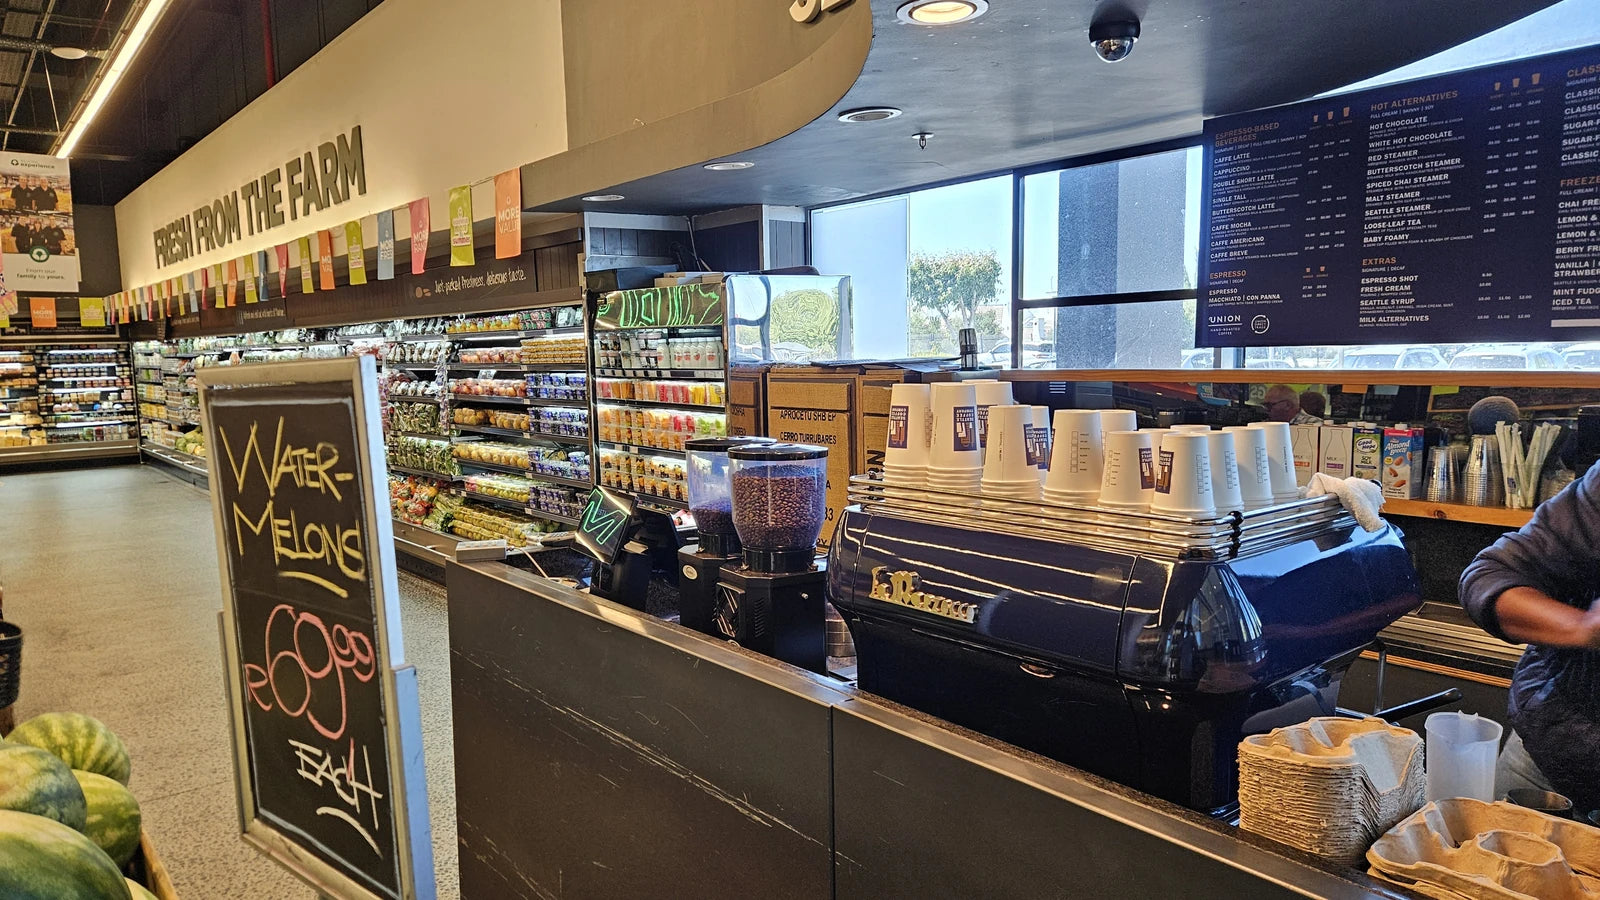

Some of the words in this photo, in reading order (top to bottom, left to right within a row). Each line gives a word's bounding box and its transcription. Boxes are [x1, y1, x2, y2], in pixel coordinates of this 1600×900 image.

[1370, 101, 1388, 112] HOT
[1391, 90, 1458, 108] ALTERNATIVES
[1369, 123, 1383, 131] HOT
[1385, 116, 1428, 128] CHOCOLATE
[1215, 133, 1257, 147] BEVERAGES
[1369, 140, 1391, 148] WHITE
[1393, 137, 1407, 145] HOT
[1410, 130, 1453, 142] CHOCOLATE
[1214, 155, 1232, 164] CAFFE
[1233, 152, 1250, 161] LATTE
[1367, 154, 1382, 162] RED
[1384, 149, 1418, 159] STEAMER
[1561, 150, 1599, 161] CLASSIC
[1214, 165, 1250, 176] CAPPUCCINO
[1367, 163, 1423, 176] BUTTERSCOTCH
[1425, 157, 1461, 167] STEAMER
[1213, 179, 1235, 188] DOUBLE
[1236, 176, 1256, 185] SHORT
[1257, 174, 1275, 182] LATTE
[1366, 181, 1392, 189] SPICED
[1393, 178, 1412, 186] CHAI
[1413, 173, 1449, 183] STEAMER
[153, 214, 194, 270] FRESH
[193, 190, 242, 254] FROM
[241, 168, 285, 236] THE
[286, 125, 367, 221] FARM
[1212, 196, 1232, 204] SINGLE
[1365, 195, 1384, 203] MALT
[1386, 191, 1420, 200] STEAMER
[1212, 205, 1256, 216] BUTTERSCOTCH
[1257, 202, 1275, 210] LATTE
[1558, 200, 1580, 209] CHAI
[1364, 208, 1394, 217] SEATTLE
[1396, 204, 1431, 213] STEAMER
[1557, 214, 1588, 224] LEMON
[1211, 224, 1230, 232] CAFFE
[1230, 221, 1252, 230] MOCHA
[1363, 221, 1406, 230] LOOSE-LEAF
[1384, 233, 1410, 241] FOAMY
[1556, 230, 1587, 239] LEMON
[1210, 239, 1228, 247] CAFFE
[1229, 236, 1265, 245] AMERICANO
[1210, 251, 1228, 259] CAFFE
[1555, 246, 1584, 254] BERRY
[1362, 256, 1397, 266] EXTRAS
[1554, 261, 1590, 270] VANILLA
[1209, 270, 1247, 279] ESPRESSO
[1361, 276, 1397, 284] ESPRESSO
[1208, 288, 1238, 296] ESPRESSO
[1384, 284, 1411, 292] CREAM
[1553, 288, 1575, 296] MINT
[1208, 295, 1241, 303] MACCHIATO
[1552, 298, 1573, 306] ICED
[1575, 297, 1592, 305] TEA
[1208, 315, 1241, 323] UNION
[1378, 315, 1430, 323] ALTERNATIVES
[779, 409, 812, 421] APROCETU
[813, 411, 826, 422] SHB
[780, 431, 798, 443] CERRO
[799, 432, 837, 445] TURRUBARES
[1385, 440, 1411, 451] Almond
[219, 416, 354, 503] WATER-
[233, 500, 367, 582] MELONS
[288, 738, 384, 830] EACH
